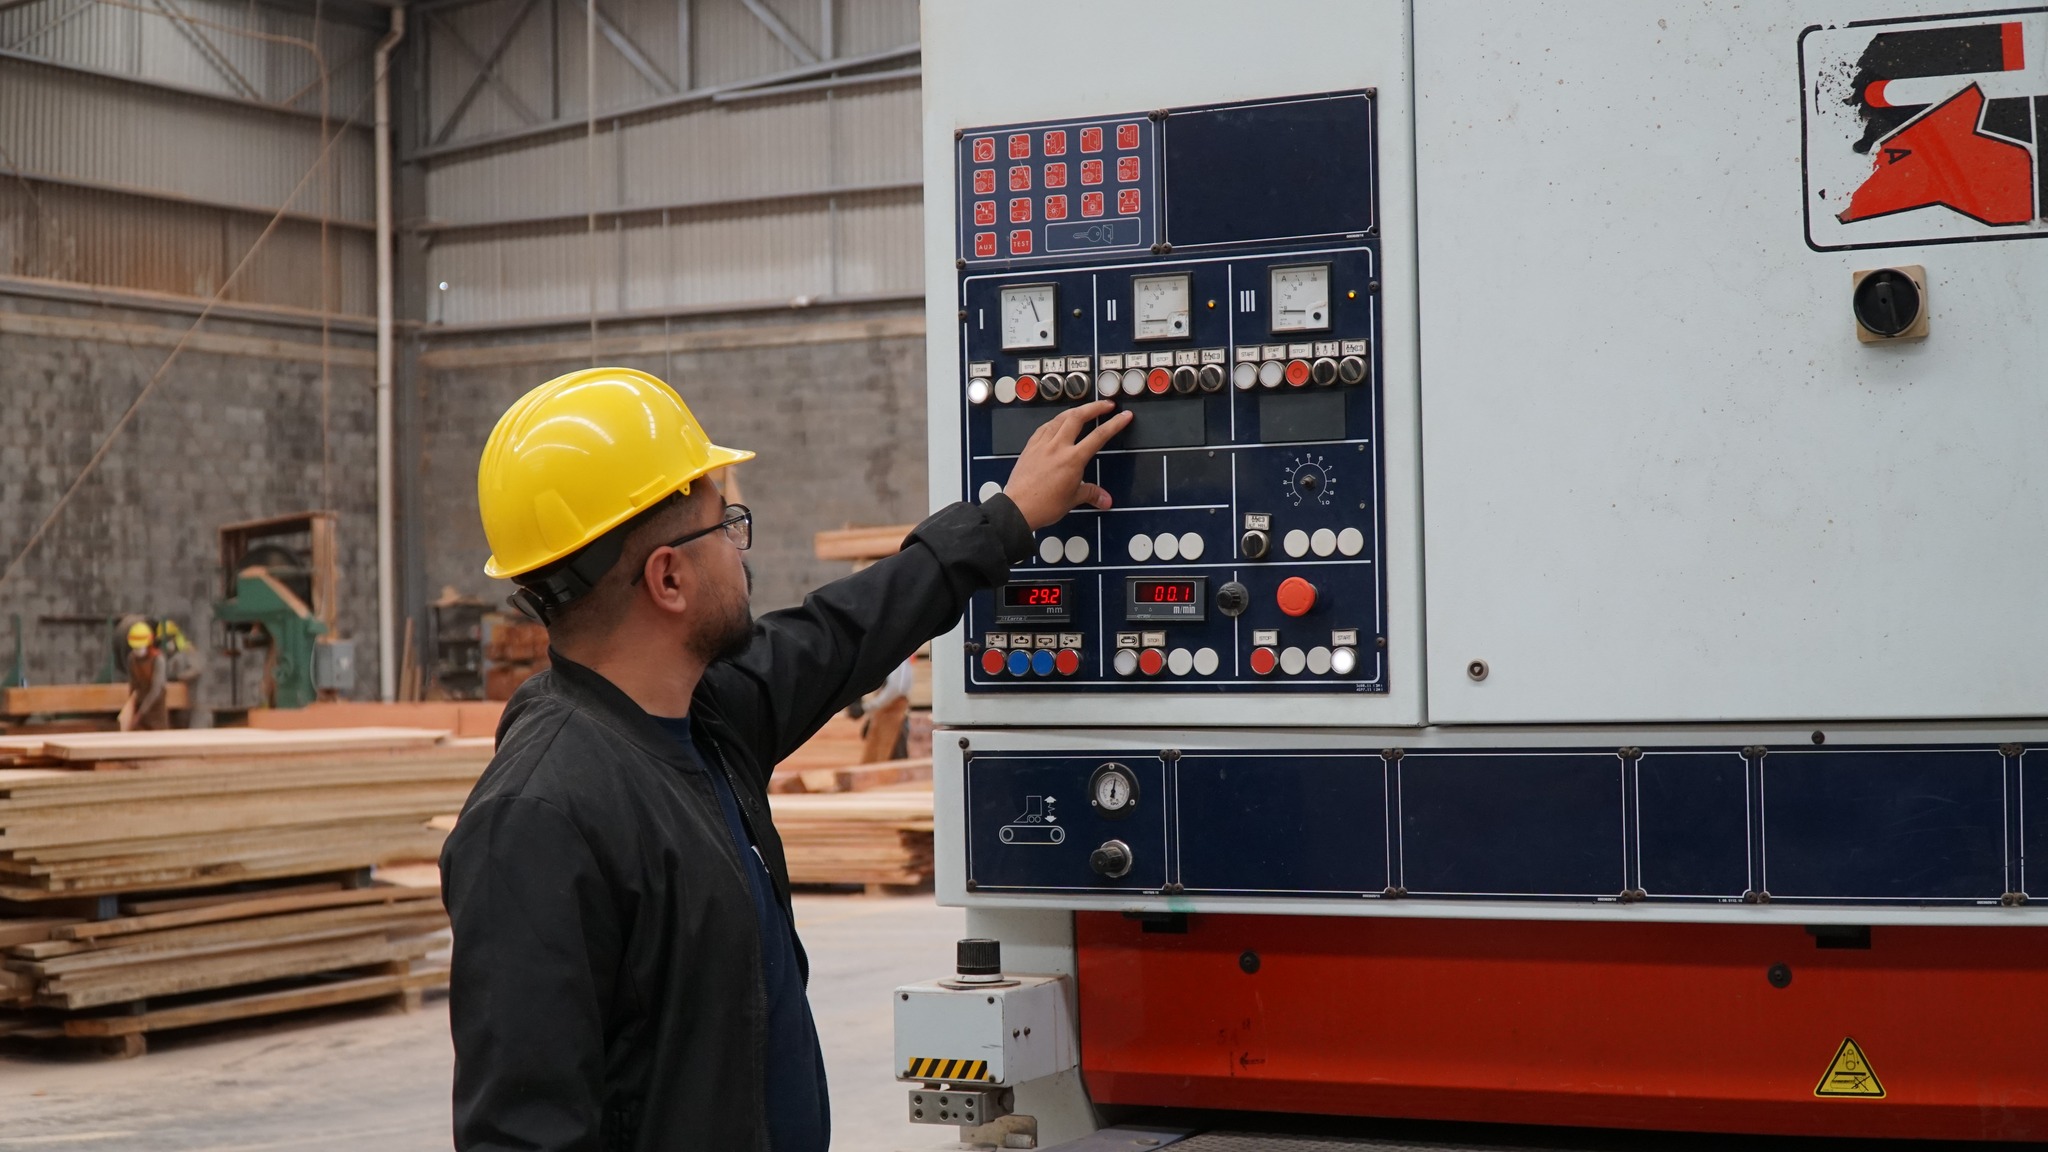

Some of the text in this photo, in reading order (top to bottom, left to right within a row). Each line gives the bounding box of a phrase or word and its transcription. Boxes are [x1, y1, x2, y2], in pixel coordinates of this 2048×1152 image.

[1030, 589, 1060, 604] 29.2
[1155, 586, 1190, 602] 00.1
[1173, 604, 1196, 614] m/min
